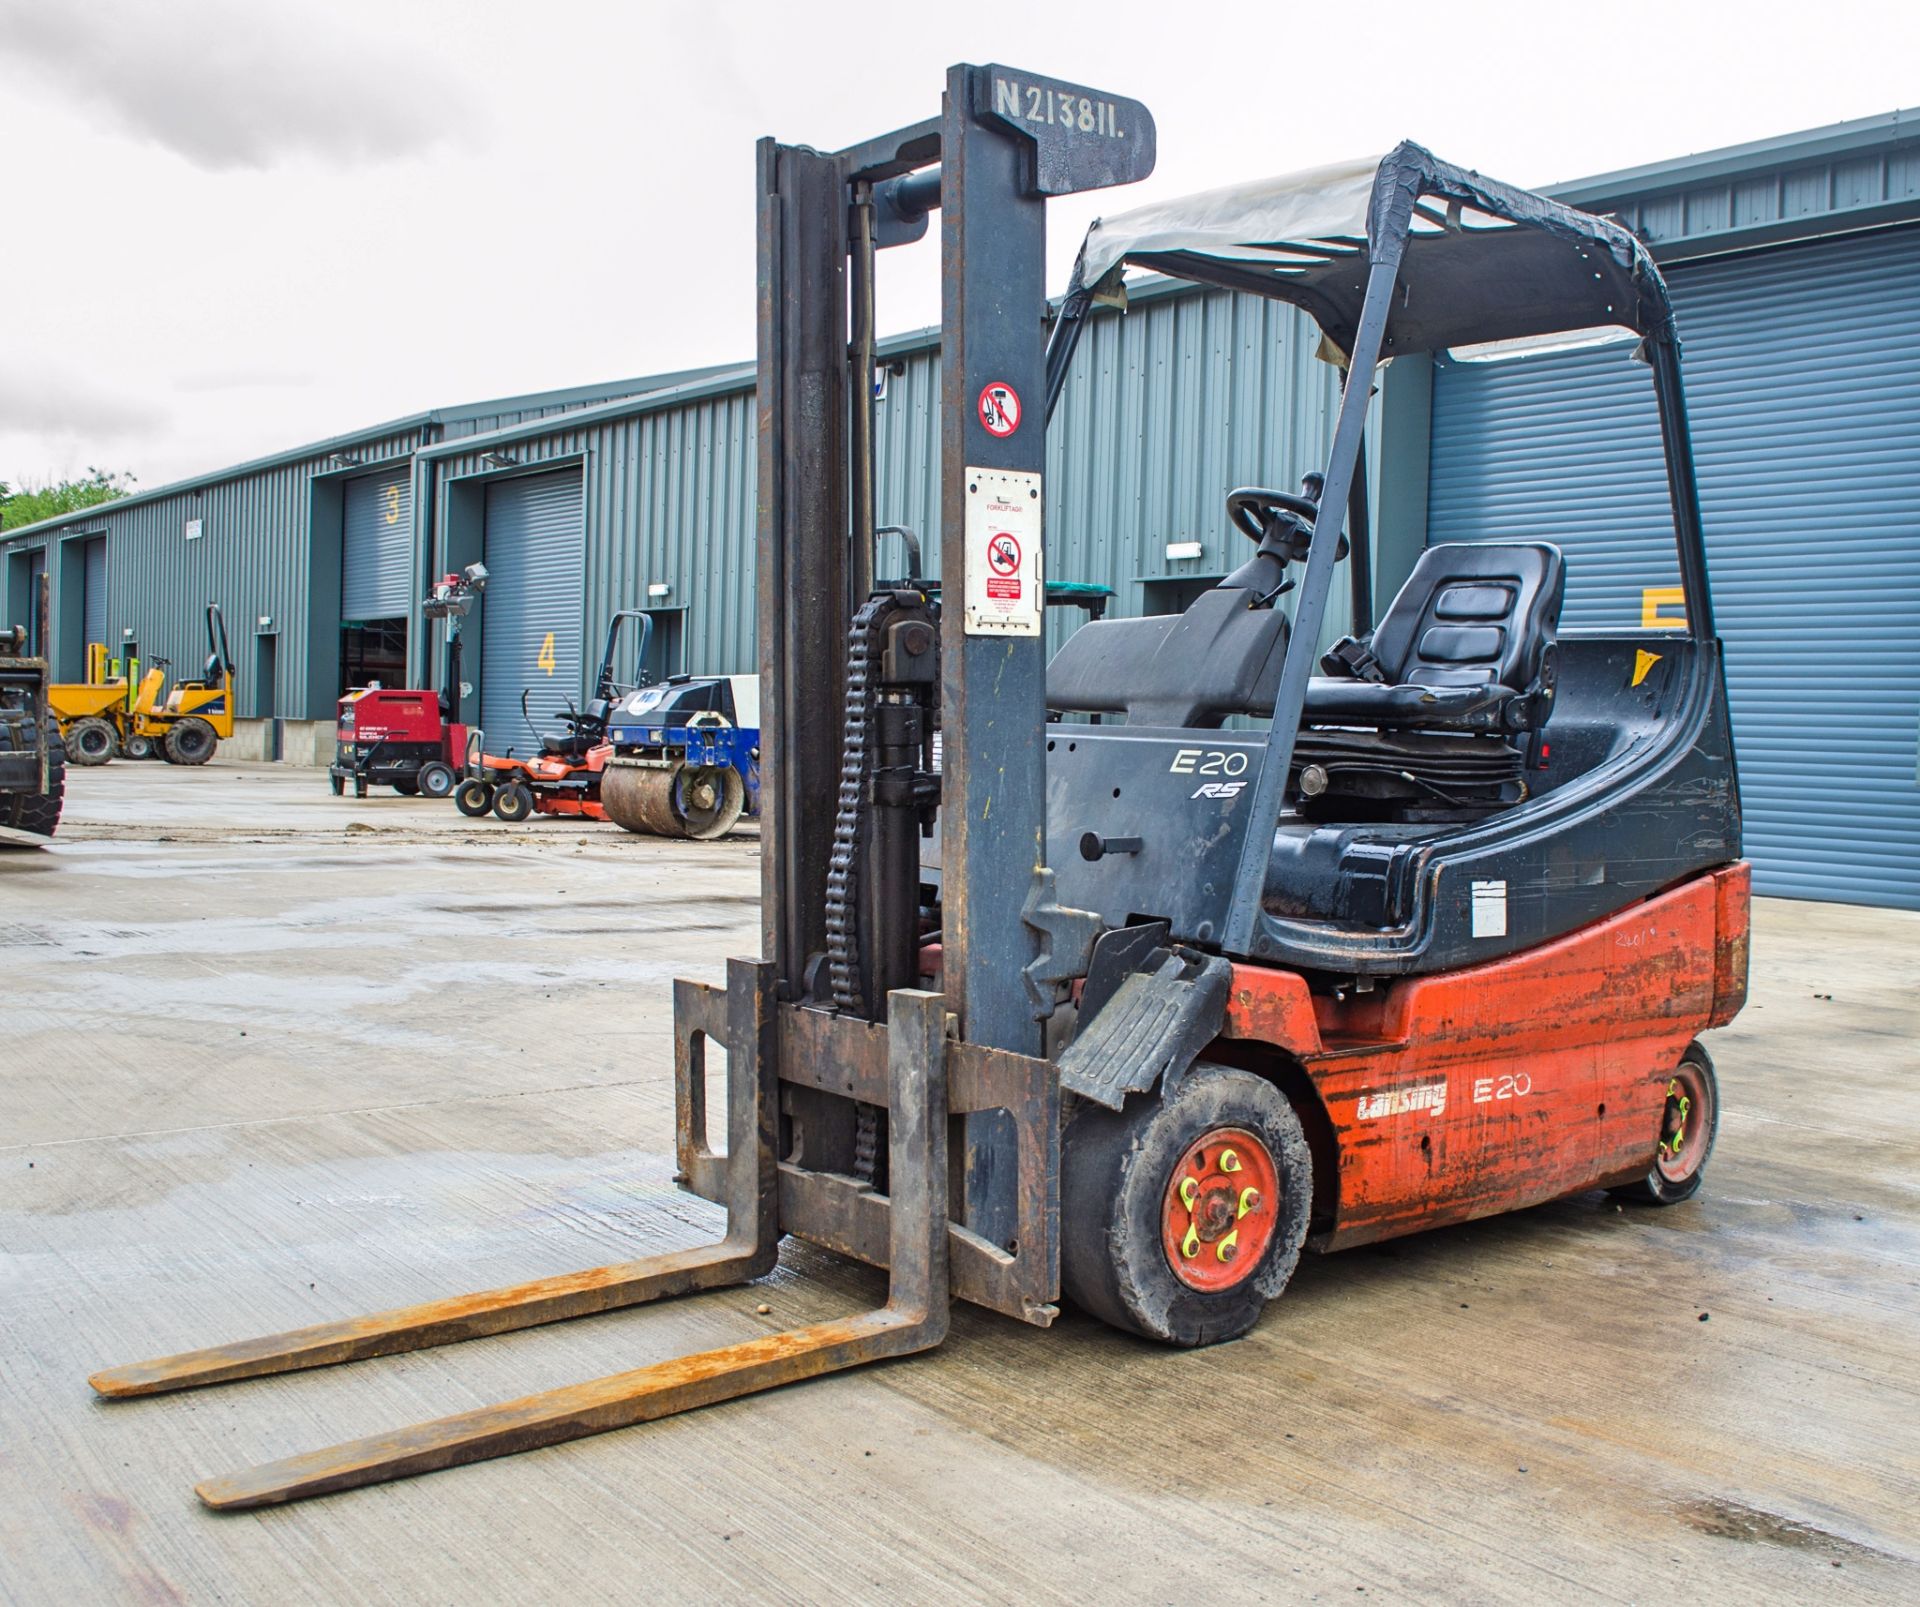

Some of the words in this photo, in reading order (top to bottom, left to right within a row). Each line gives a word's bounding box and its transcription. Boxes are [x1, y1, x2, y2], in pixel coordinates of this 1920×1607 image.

[386, 485, 398, 524] 3
[537, 632, 555, 676] 4
[1190, 781, 1248, 799] RS
